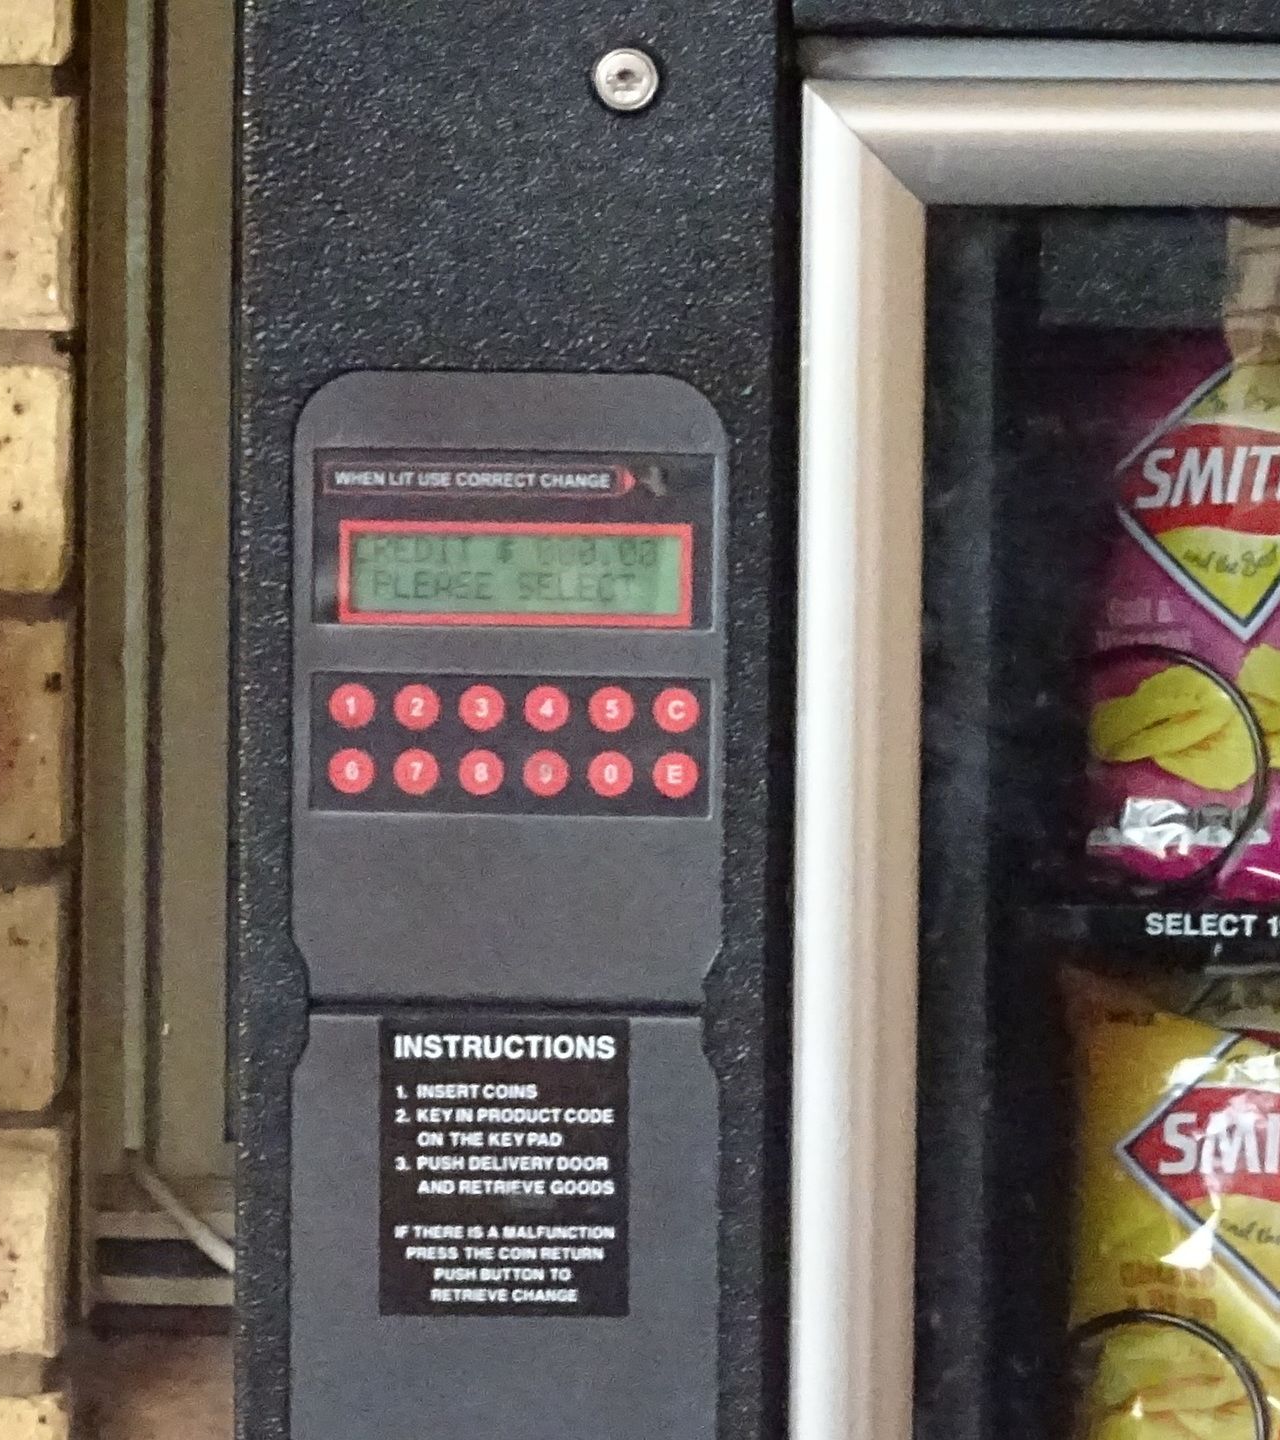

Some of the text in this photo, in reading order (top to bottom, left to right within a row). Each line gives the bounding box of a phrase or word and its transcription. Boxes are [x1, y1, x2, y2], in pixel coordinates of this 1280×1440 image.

[335, 470, 610, 489] WHEN LIT USE CORRECT CHANGE
[345, 697, 686, 720] 1 2 3 4 5 C
[345, 762, 358, 781] 6
[410, 762, 423, 781] 7
[474, 763, 488, 782] 8
[667, 765, 682, 784] E
[1145, 913, 1256, 937] SELECT
[394, 1034, 616, 1060] INSTRUCTIONS
[395, 1084, 538, 1100] 1. INSERT COINS
[395, 1108, 615, 1124] 2. KEY IN PRODUCT CODE
[417, 1131, 443, 1147] ON
[450, 1131, 484, 1147] THE
[395, 1155, 609, 1171] 3. PUSH DELIVERY DOOR
[417, 1179, 615, 1195] AND RETRIEVE GOODS
[394, 1225, 615, 1240] IF THERE IS A MALFUNCTION
[406, 1247, 605, 1261] PRESS THE COIN RETURN
[434, 1267, 572, 1281] PUSH BUTTON TO
[430, 1288, 578, 1303] RETRIEVE CHANGE
